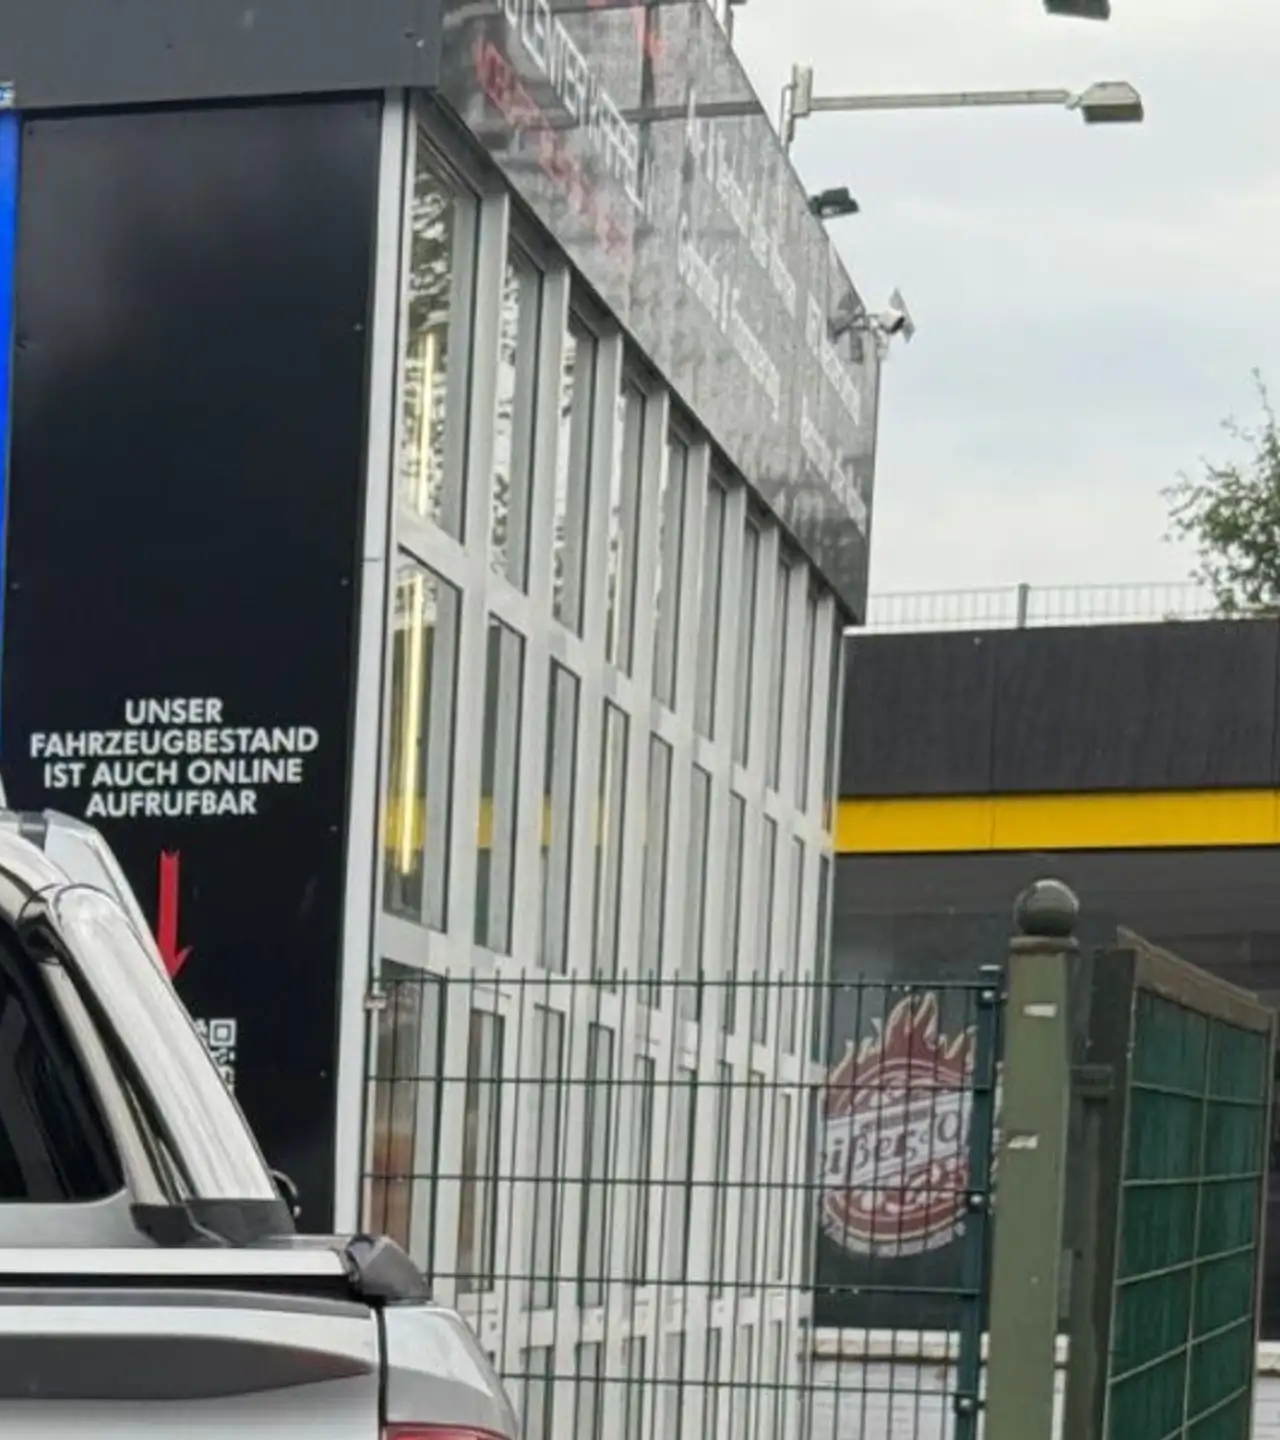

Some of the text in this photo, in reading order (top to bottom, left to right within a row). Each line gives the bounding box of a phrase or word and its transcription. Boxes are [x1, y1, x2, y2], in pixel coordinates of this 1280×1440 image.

[125, 697, 224, 725] UNSER
[30, 726, 320, 758] FAHRZEUGBESTAND
[44, 757, 303, 788] IST AUCH ONLINE
[84, 789, 258, 818] AUFRUFBAR
